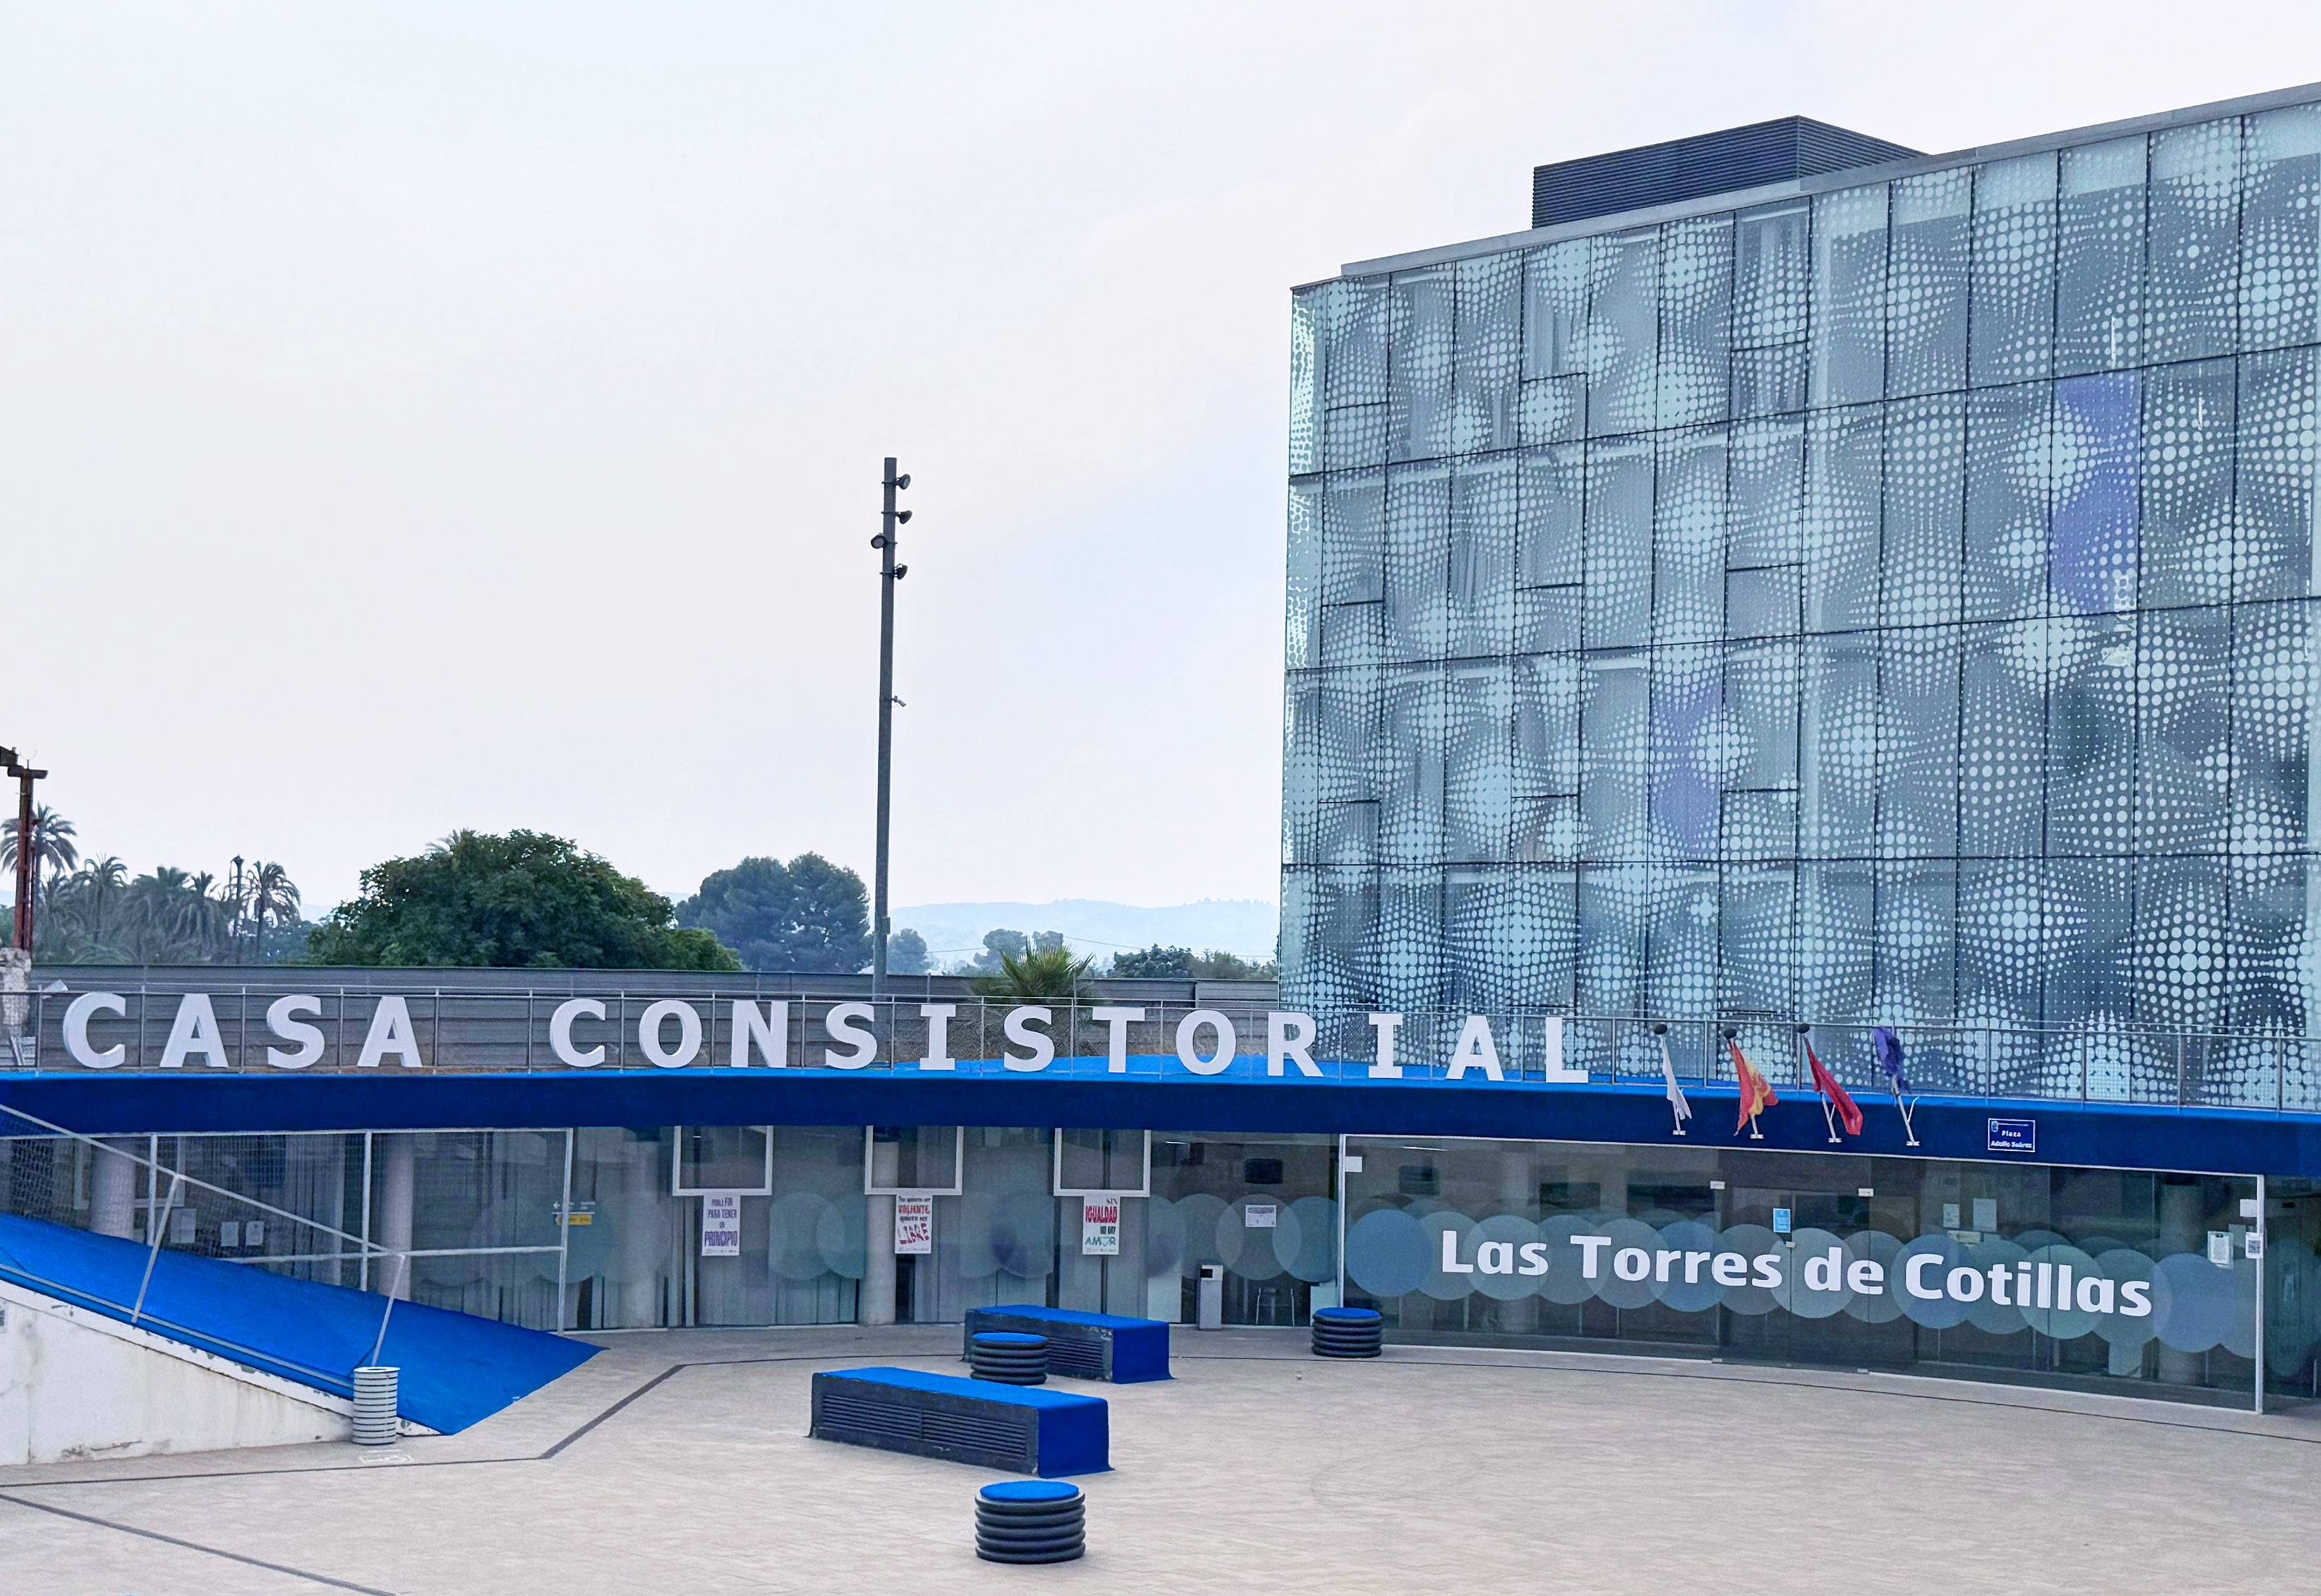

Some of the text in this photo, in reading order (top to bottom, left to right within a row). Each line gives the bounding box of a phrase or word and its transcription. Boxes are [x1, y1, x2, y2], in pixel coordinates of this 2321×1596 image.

[63, 992, 1589, 1083] CASA CONSISTORIAL
[708, 1209, 721, 1219] PARA
[1085, 1206, 1118, 1223] IGUALDAD
[704, 1231, 738, 1247] PRINCIPIO
[1442, 1230, 2153, 1318] Las Torres de Cotillas
